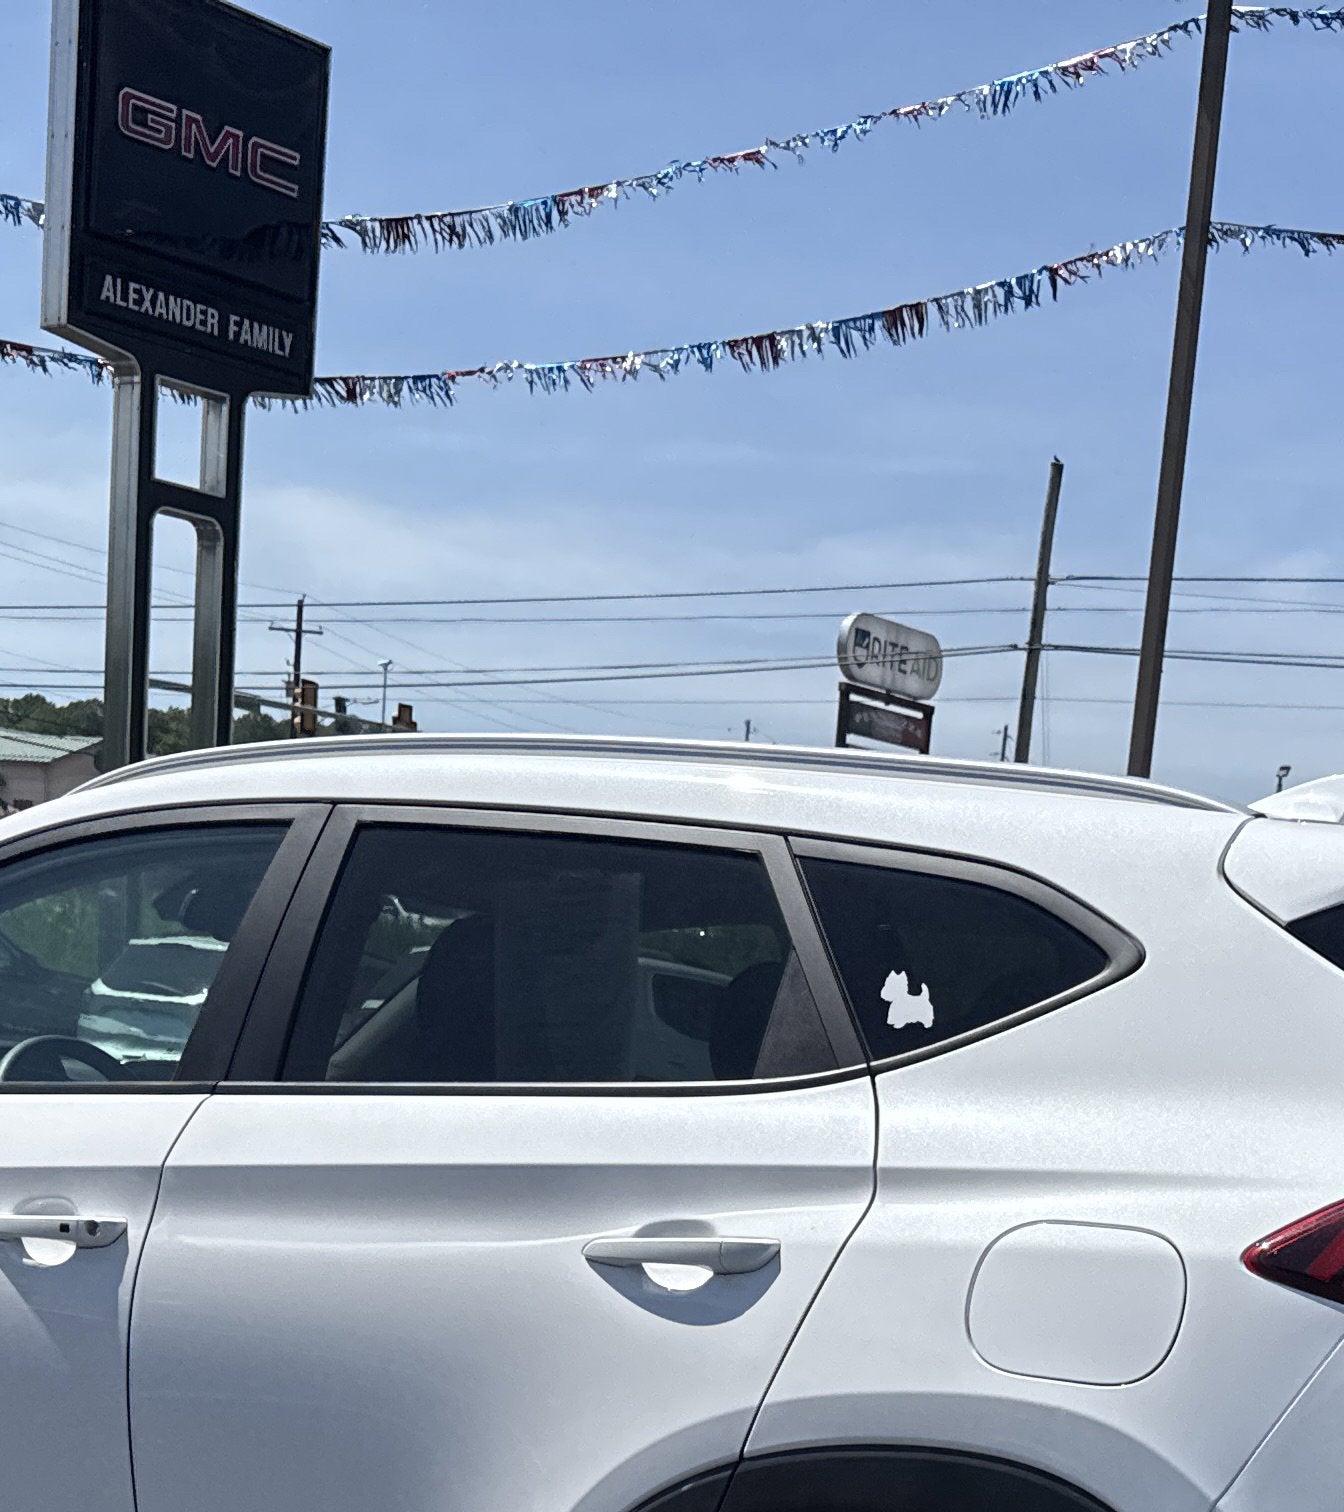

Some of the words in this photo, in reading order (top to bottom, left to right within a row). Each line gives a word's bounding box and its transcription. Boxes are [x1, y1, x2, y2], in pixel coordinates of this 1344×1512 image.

[118, 86, 301, 199] GMC
[100, 274, 219, 337] ALEXANDER
[228, 314, 294, 359] FAMILY
[910, 656, 939, 682] AID
